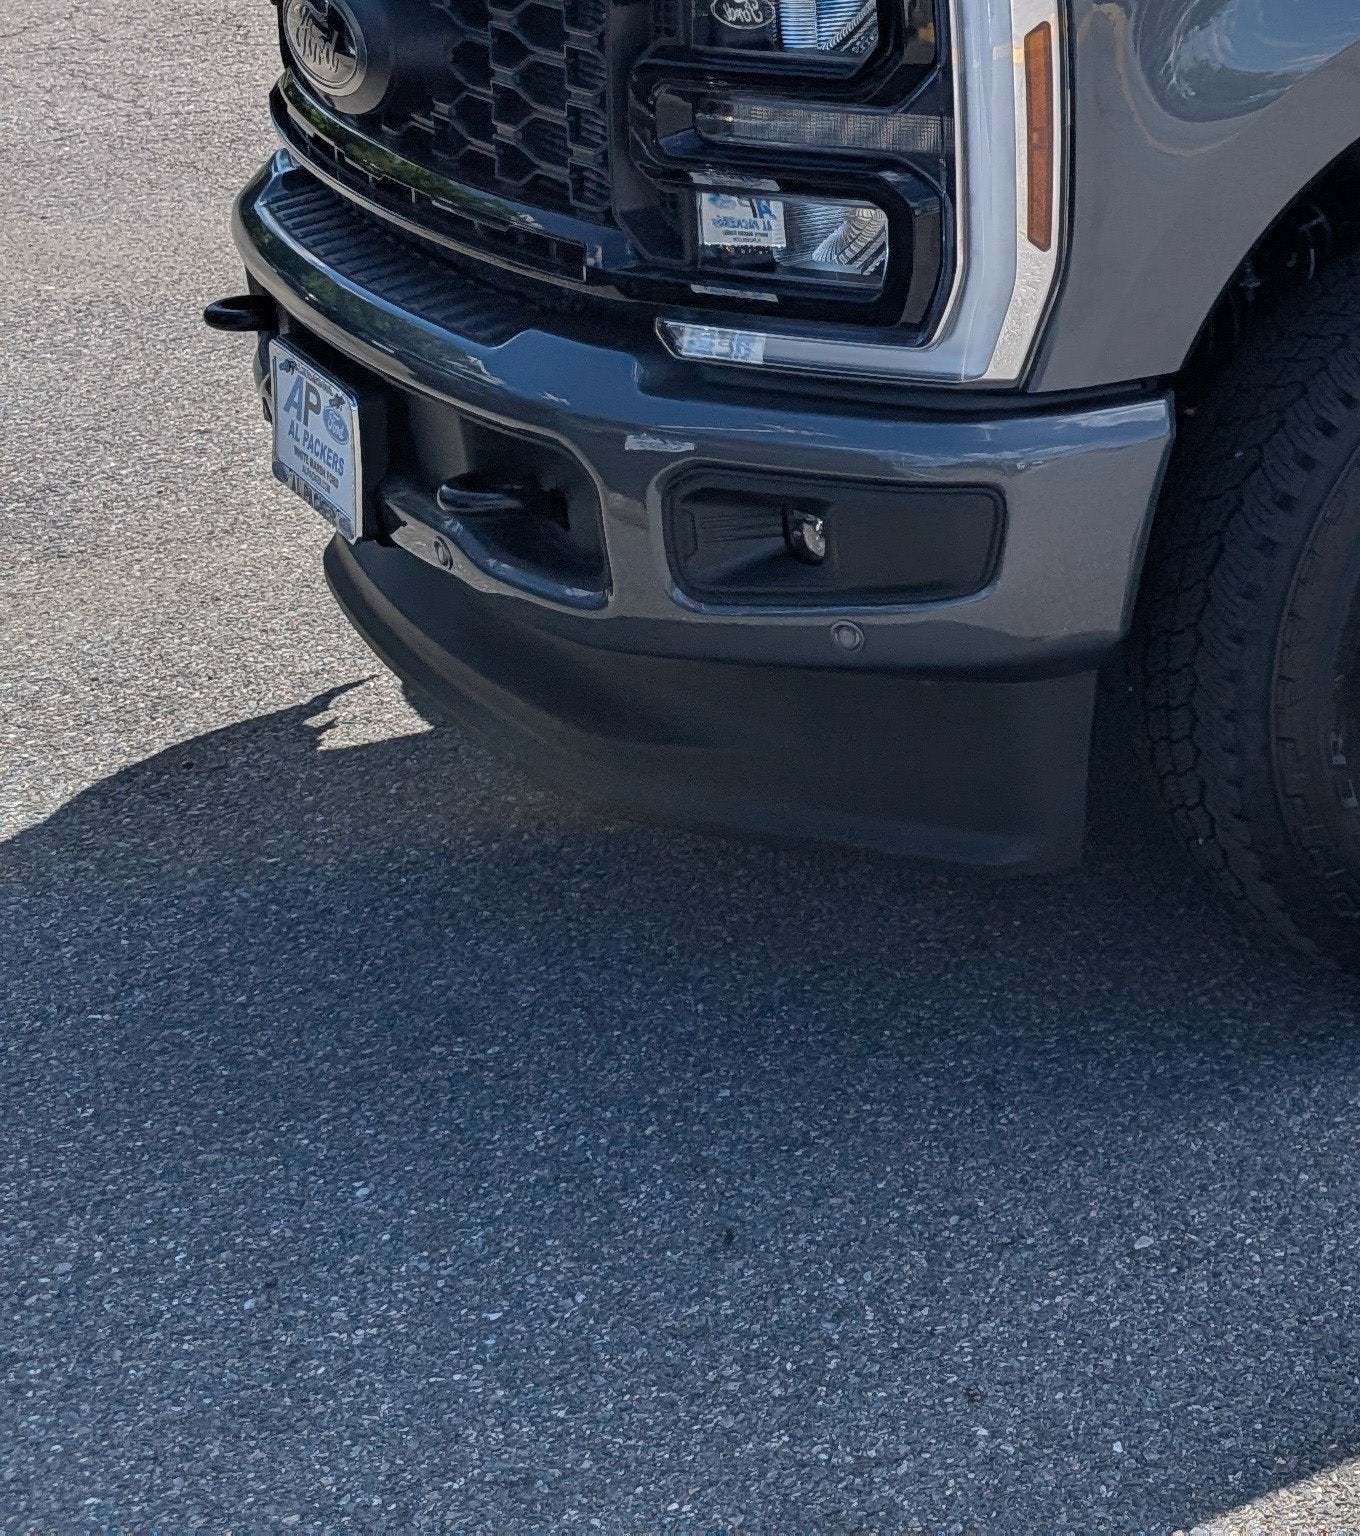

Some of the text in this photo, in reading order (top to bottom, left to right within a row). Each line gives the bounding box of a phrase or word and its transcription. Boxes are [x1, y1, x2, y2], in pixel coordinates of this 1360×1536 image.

[283, 374, 321, 427] AP
[288, 420, 300, 446] AL
[302, 431, 345, 478] PACKERS
